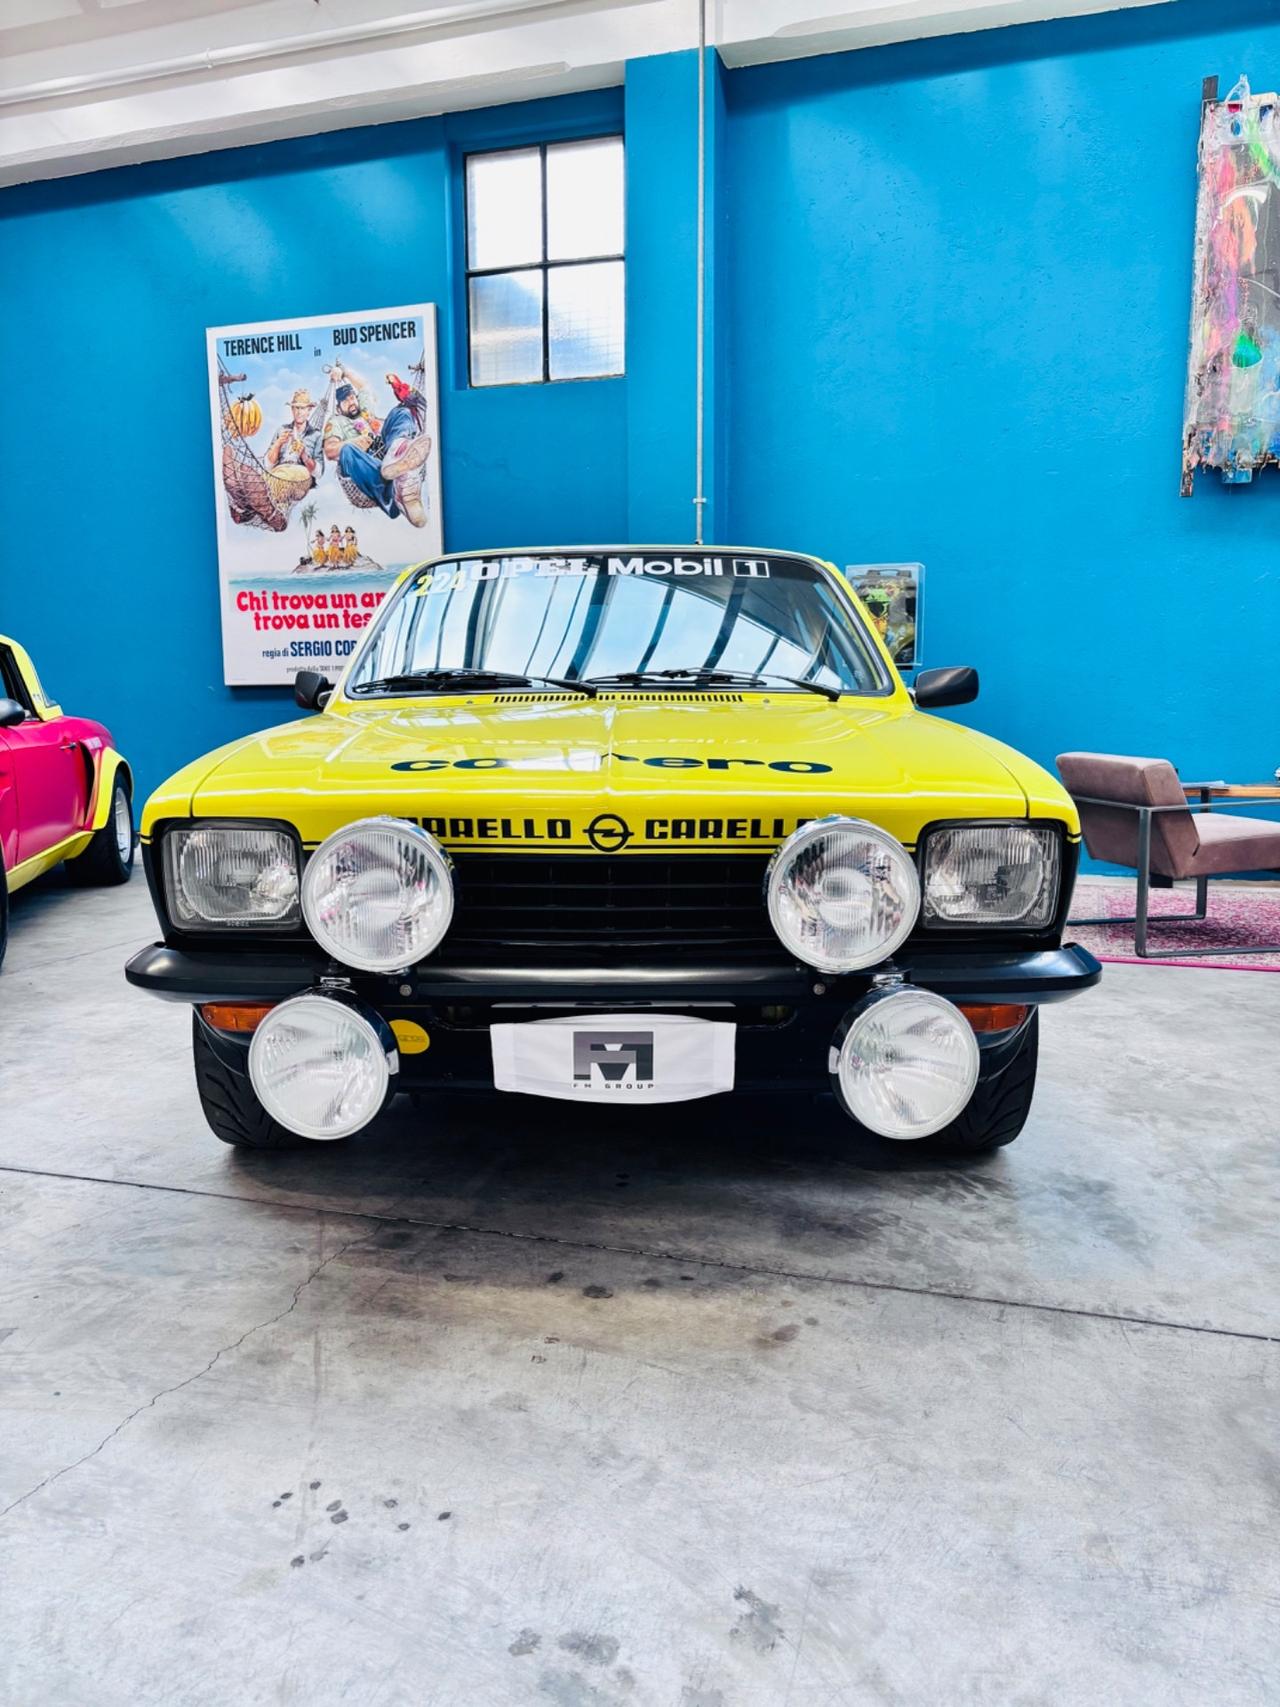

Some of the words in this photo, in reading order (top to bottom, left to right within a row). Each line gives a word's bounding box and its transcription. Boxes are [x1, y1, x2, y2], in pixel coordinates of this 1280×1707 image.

[333, 327, 358, 346] BUD
[360, 320, 416, 343] SPENCER
[223, 336, 274, 357] TERENCE
[277, 333, 302, 352] HILL
[607, 557, 724, 576] Mobil
[236, 590, 269, 612] Chi
[272, 591, 328, 611] trova
[331, 593, 358, 609] un
[254, 612, 310, 631] trova
[313, 613, 340, 629] un
[262, 648, 281, 659] regia
[282, 648, 289, 657] di
[290, 640, 332, 657] SERGIO
[645, 818, 818, 840] CARELL
